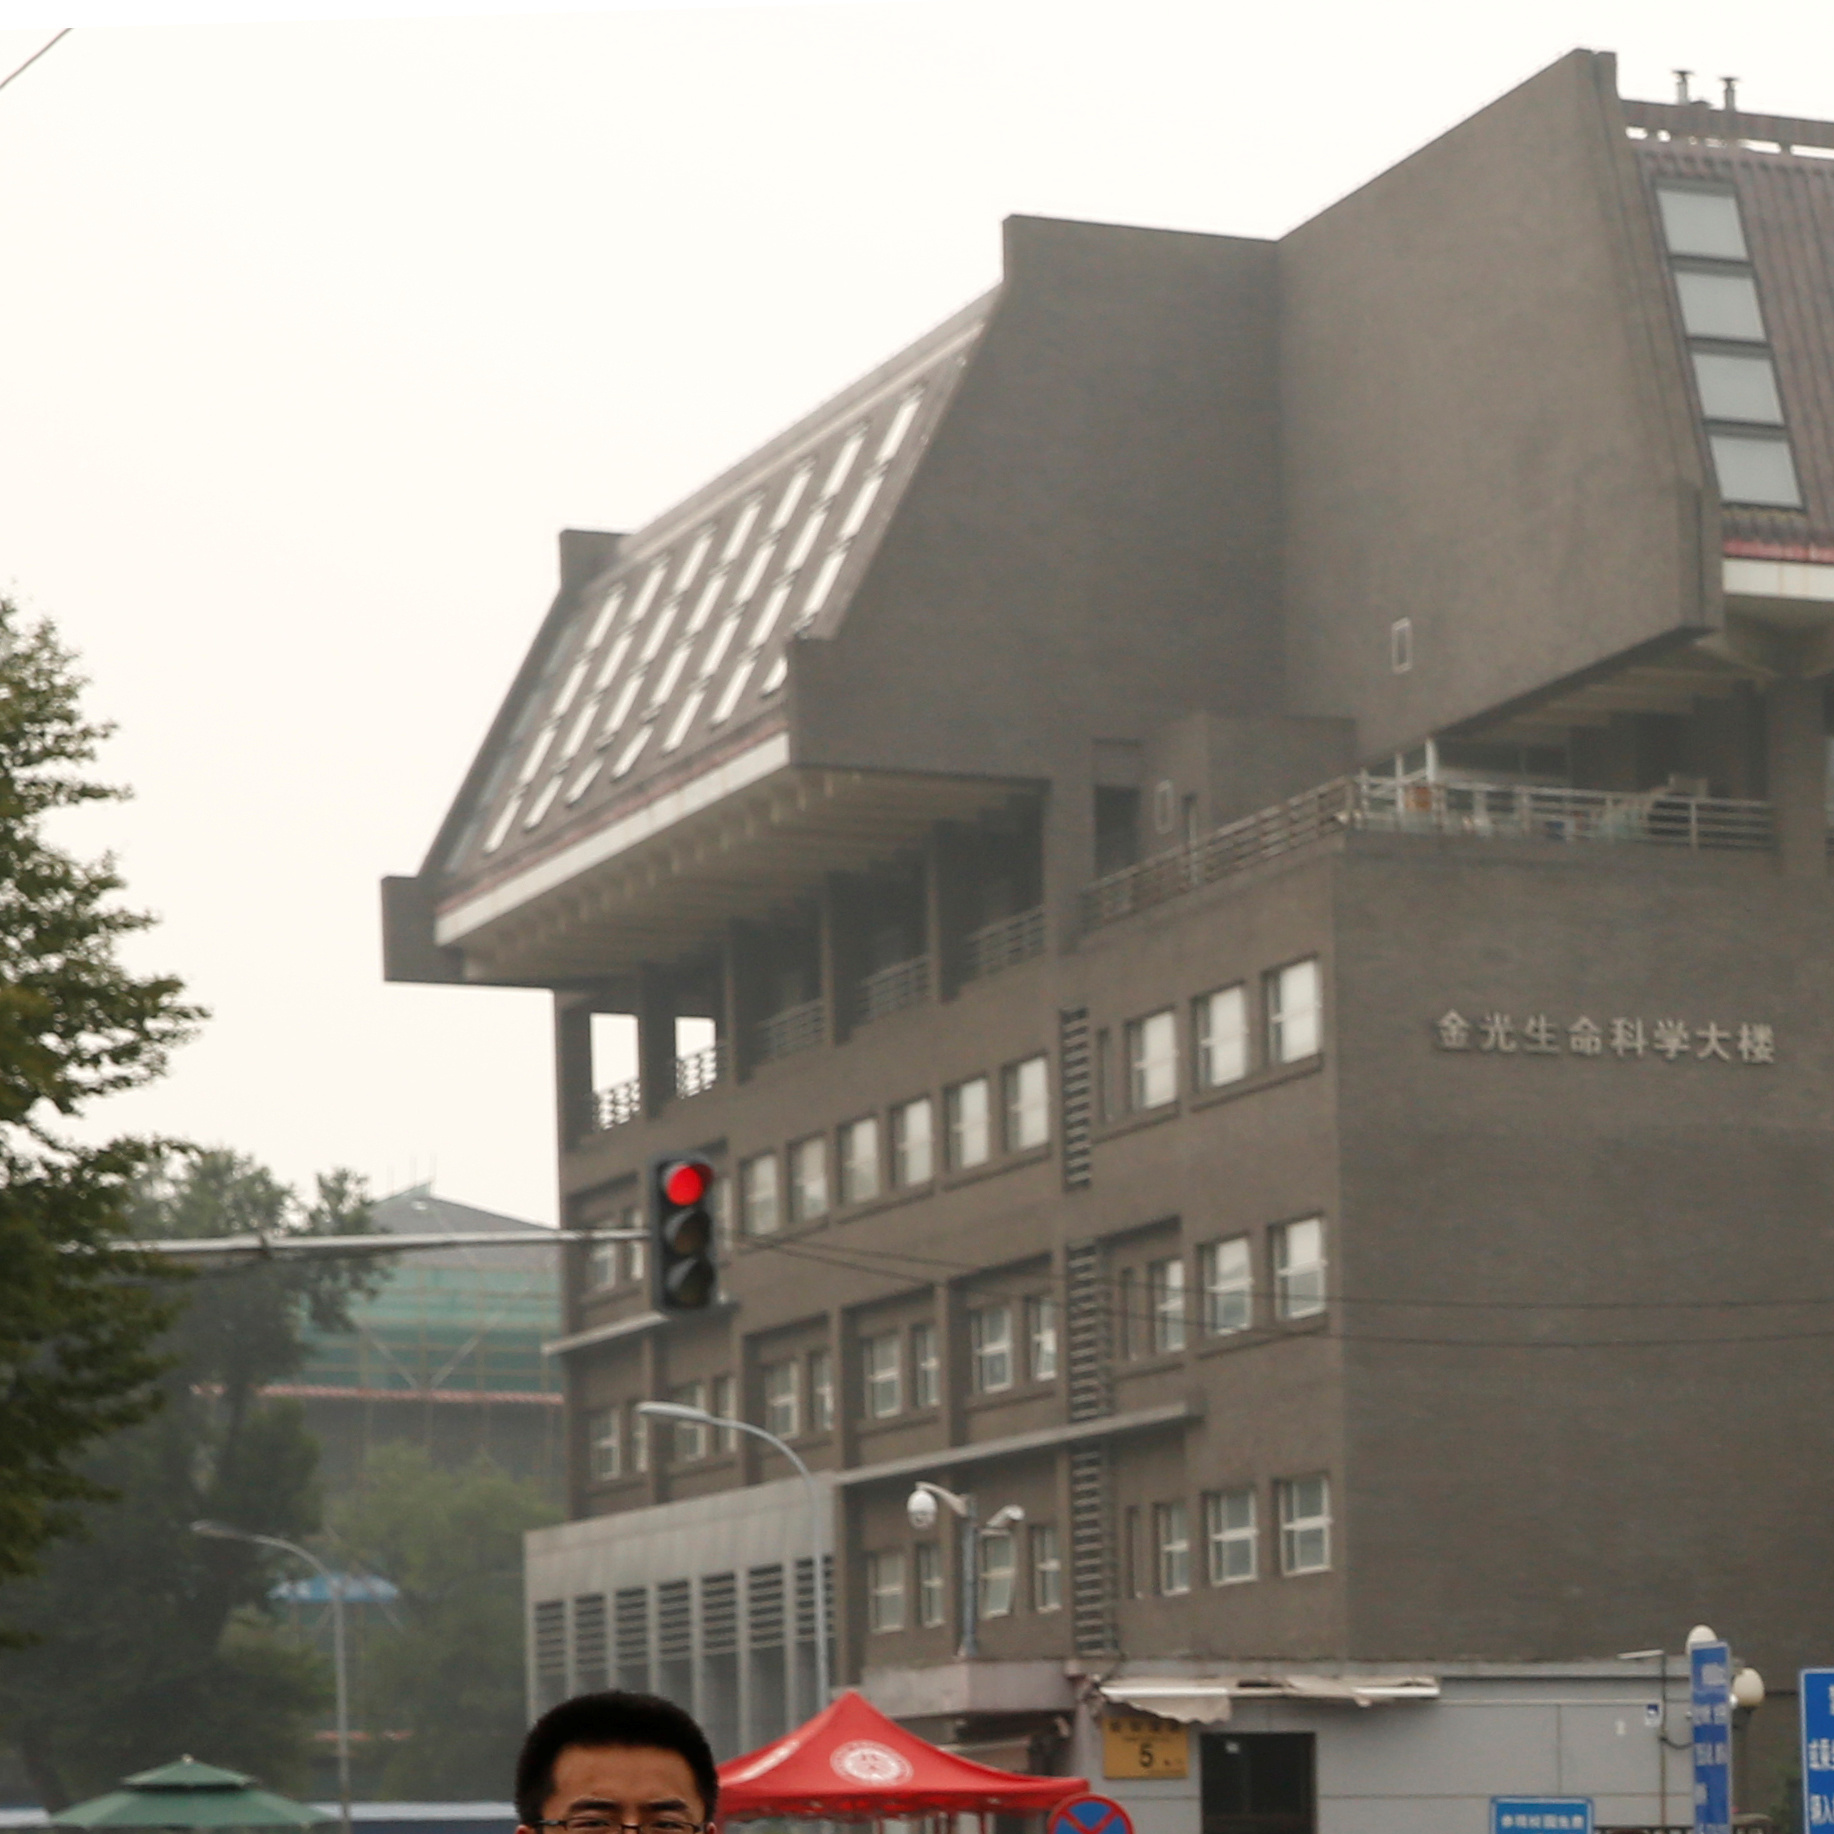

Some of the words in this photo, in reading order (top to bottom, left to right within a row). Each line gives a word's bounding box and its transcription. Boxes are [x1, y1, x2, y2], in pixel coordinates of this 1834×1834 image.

[1437, 1008, 1775, 1064] 金光生命科学大楼
[1140, 1743, 1154, 1768] 5
